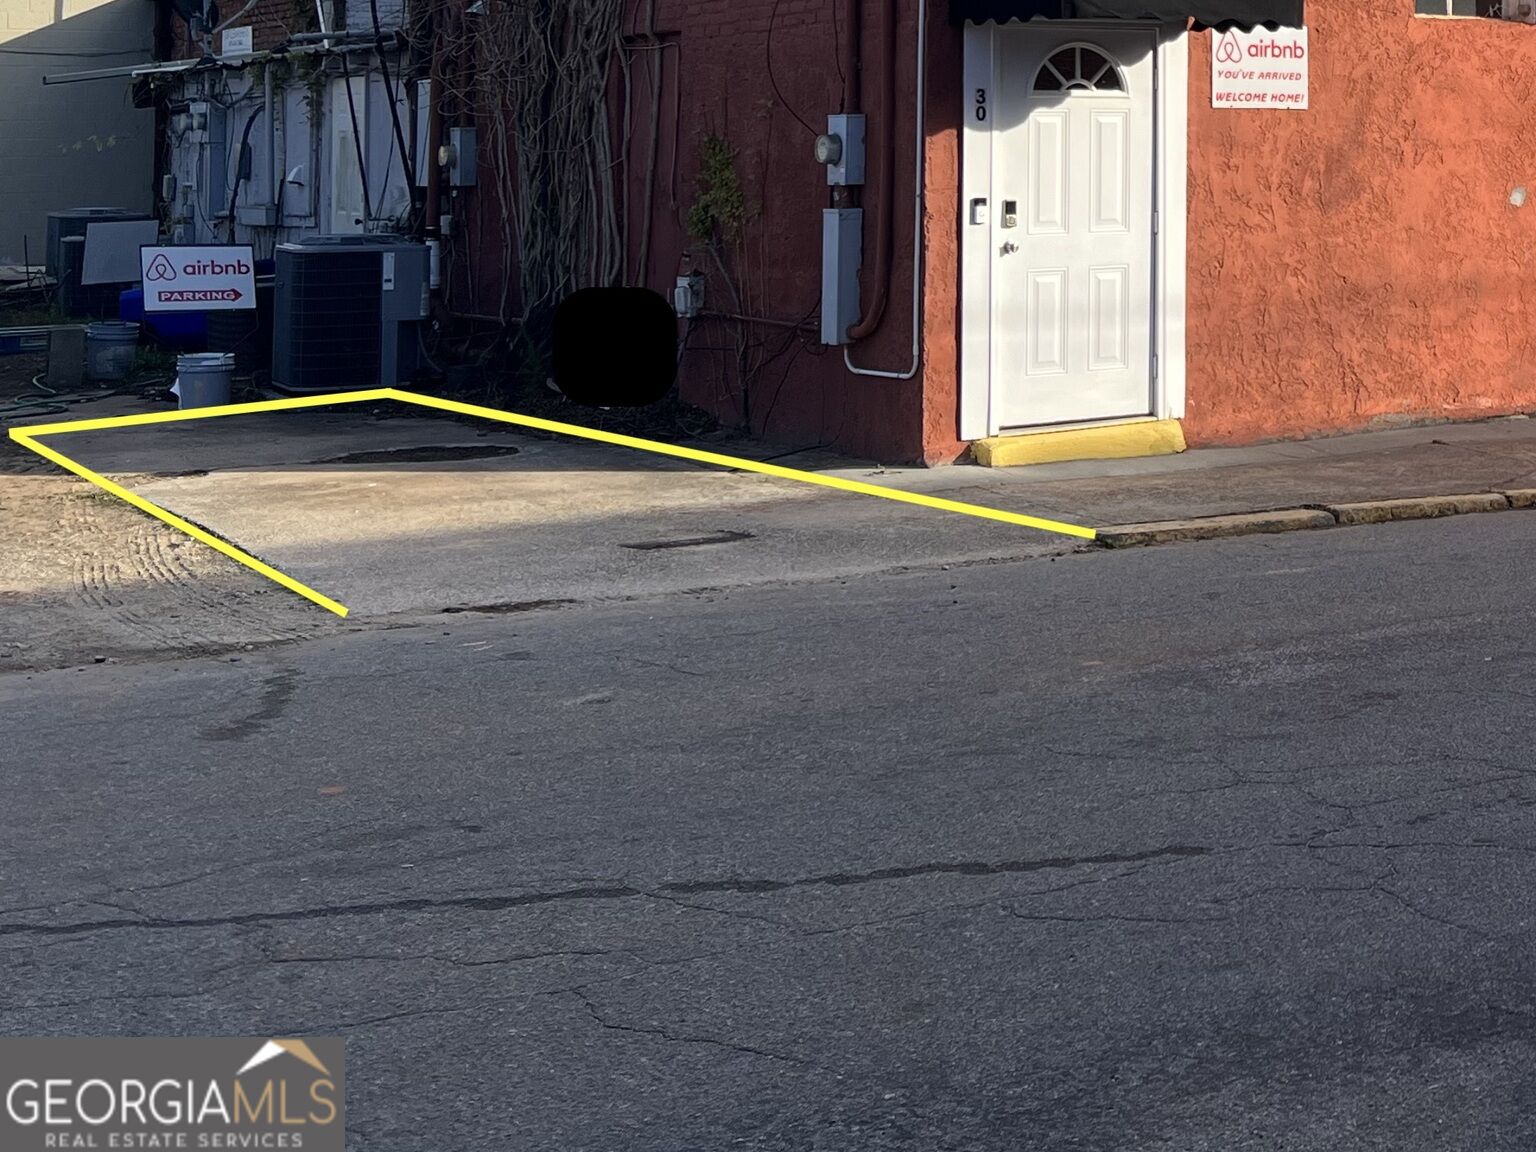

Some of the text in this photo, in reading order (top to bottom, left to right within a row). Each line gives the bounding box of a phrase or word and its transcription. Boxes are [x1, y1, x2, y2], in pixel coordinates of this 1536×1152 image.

[1247, 39, 1305, 59] airbnb
[1217, 69, 1302, 81] YOU'VE ARRIVED
[1215, 92, 1305, 103] WELCOME HOME!
[183, 259, 250, 275] airbnb
[161, 291, 236, 301] PARKING
